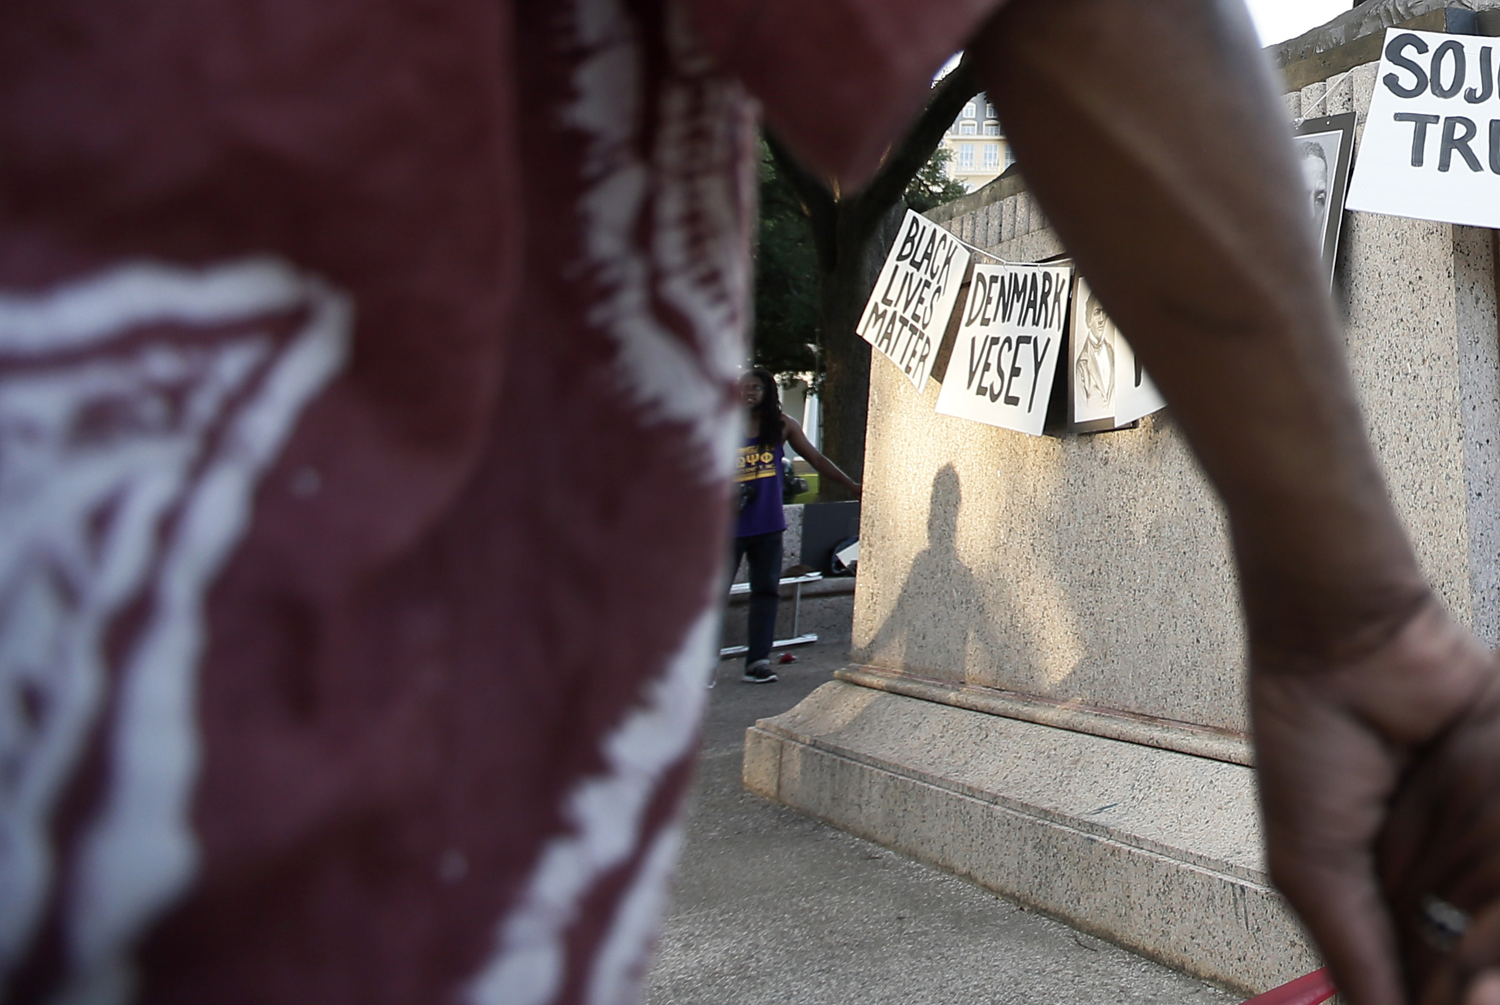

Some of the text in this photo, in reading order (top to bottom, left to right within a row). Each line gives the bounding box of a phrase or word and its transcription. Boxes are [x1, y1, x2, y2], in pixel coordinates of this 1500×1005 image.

[895, 215, 959, 296] BLACK
[881, 264, 942, 330] LIVES
[964, 271, 1066, 332] DENMARK
[861, 301, 931, 379] MATTER
[966, 334, 1051, 414] VESEY
